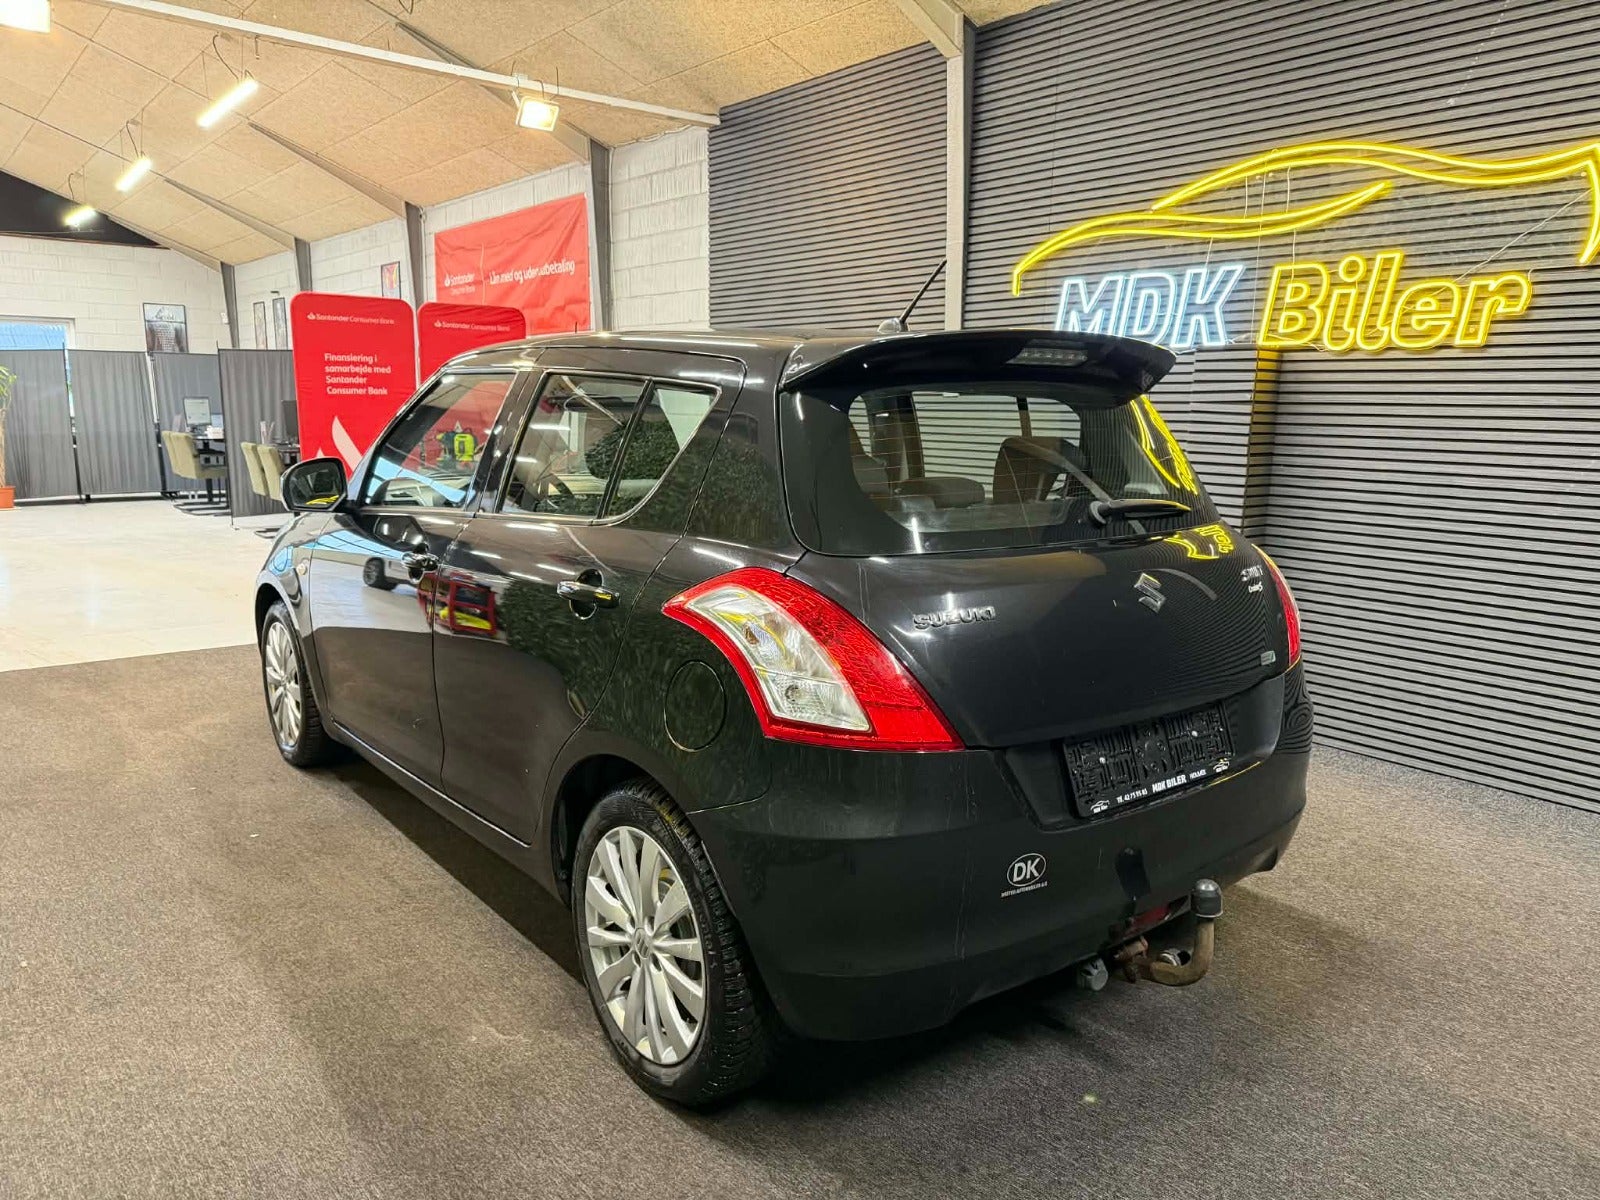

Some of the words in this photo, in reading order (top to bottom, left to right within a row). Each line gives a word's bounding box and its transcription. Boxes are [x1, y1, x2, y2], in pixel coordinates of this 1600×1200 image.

[514, 270, 523, 284] og
[1054, 263, 1244, 349] MDK
[1257, 250, 1533, 352] Biler
[316, 313, 348, 322] Santander
[442, 321, 471, 329] Santander
[324, 352, 374, 365] Finansiering
[325, 365, 373, 374] samarbejde
[373, 366, 392, 374] med
[325, 375, 368, 384] Santander
[326, 386, 367, 395] Consumer
[367, 387, 388, 395] Bank
[913, 605, 996, 631] SUZUKI
[1152, 780, 1167, 793] MDK
[1166, 774, 1187, 788] BILER
[1013, 857, 1041, 882] DK
